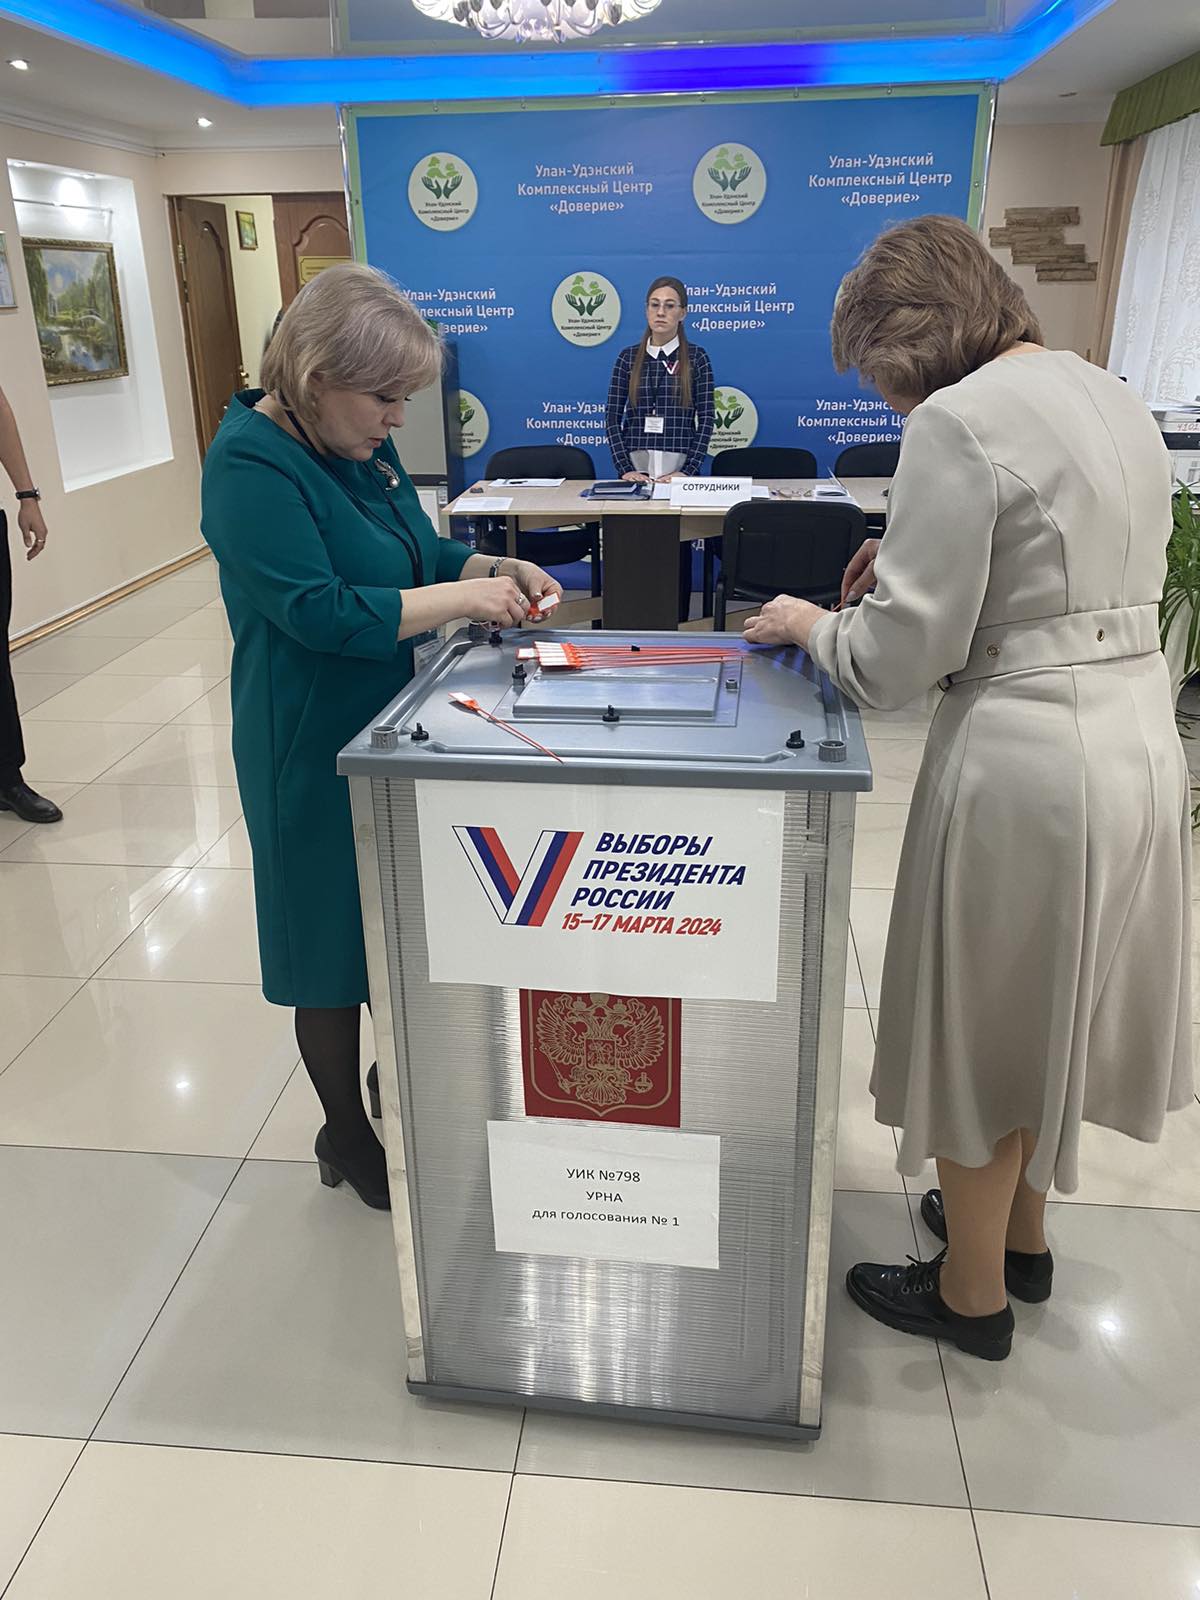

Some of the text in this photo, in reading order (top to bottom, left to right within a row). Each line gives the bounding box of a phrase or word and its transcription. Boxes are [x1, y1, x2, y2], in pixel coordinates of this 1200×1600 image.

[828, 152, 933, 168] Улан-Удэнский
[535, 162, 634, 178] Улан-Удэнский
[808, 172, 952, 187] Комплексный Центр
[518, 181, 653, 196] Комплексный Центр
[841, 192, 920, 206] «Доверие»
[550, 200, 624, 214] «Доверие»
[684, 283, 776, 297] лан-Удэнский
[476, 305, 515, 318] Центр
[687, 300, 795, 314] плексный Центр
[692, 318, 765, 332] «Доверие»
[542, 402, 606, 415] Улан-Удэн
[816, 399, 892, 412] Улан-Удэнс
[526, 417, 607, 429] Комплексны
[797, 415, 887, 427] Комплексный
[556, 433, 609, 447] «Довери
[682, 483, 740, 492] СОТРУДНИКИ
[595, 832, 714, 857] ВЫБОРЫ
[583, 860, 747, 886] ПРЕЗИДЕНТА
[571, 887, 675, 911] РОССИИ
[612, 915, 674, 934] МАРТА
[676, 917, 723, 936] 2024
[566, 1168, 641, 1183] УИК №798
[586, 1191, 623, 1203] УРНА
[532, 1210, 680, 1227] для голосования № 1
